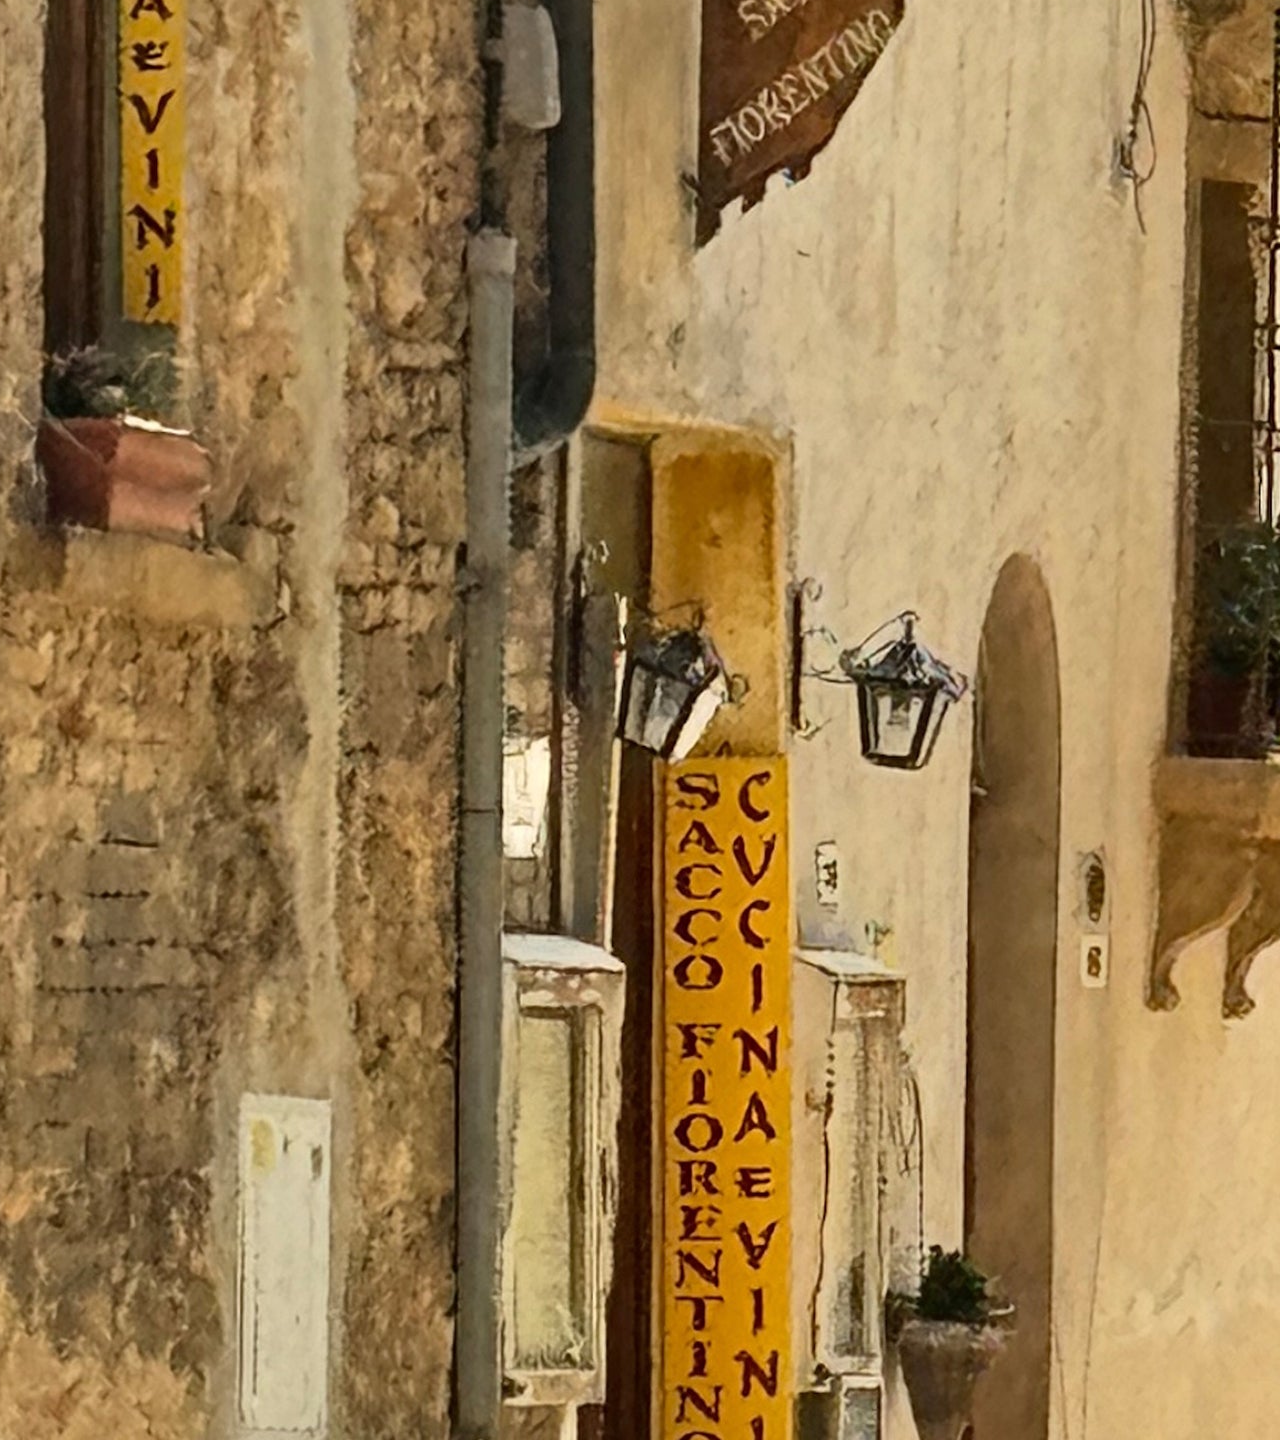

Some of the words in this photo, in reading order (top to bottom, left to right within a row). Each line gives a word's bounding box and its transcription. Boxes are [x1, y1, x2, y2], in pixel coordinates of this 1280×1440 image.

[130, 41, 169, 72] E
[710, 9, 895, 166] FIORENTINO
[127, 88, 175, 316] VINI
[673, 773, 723, 992] SACCO
[734, 1166, 772, 1199] E
